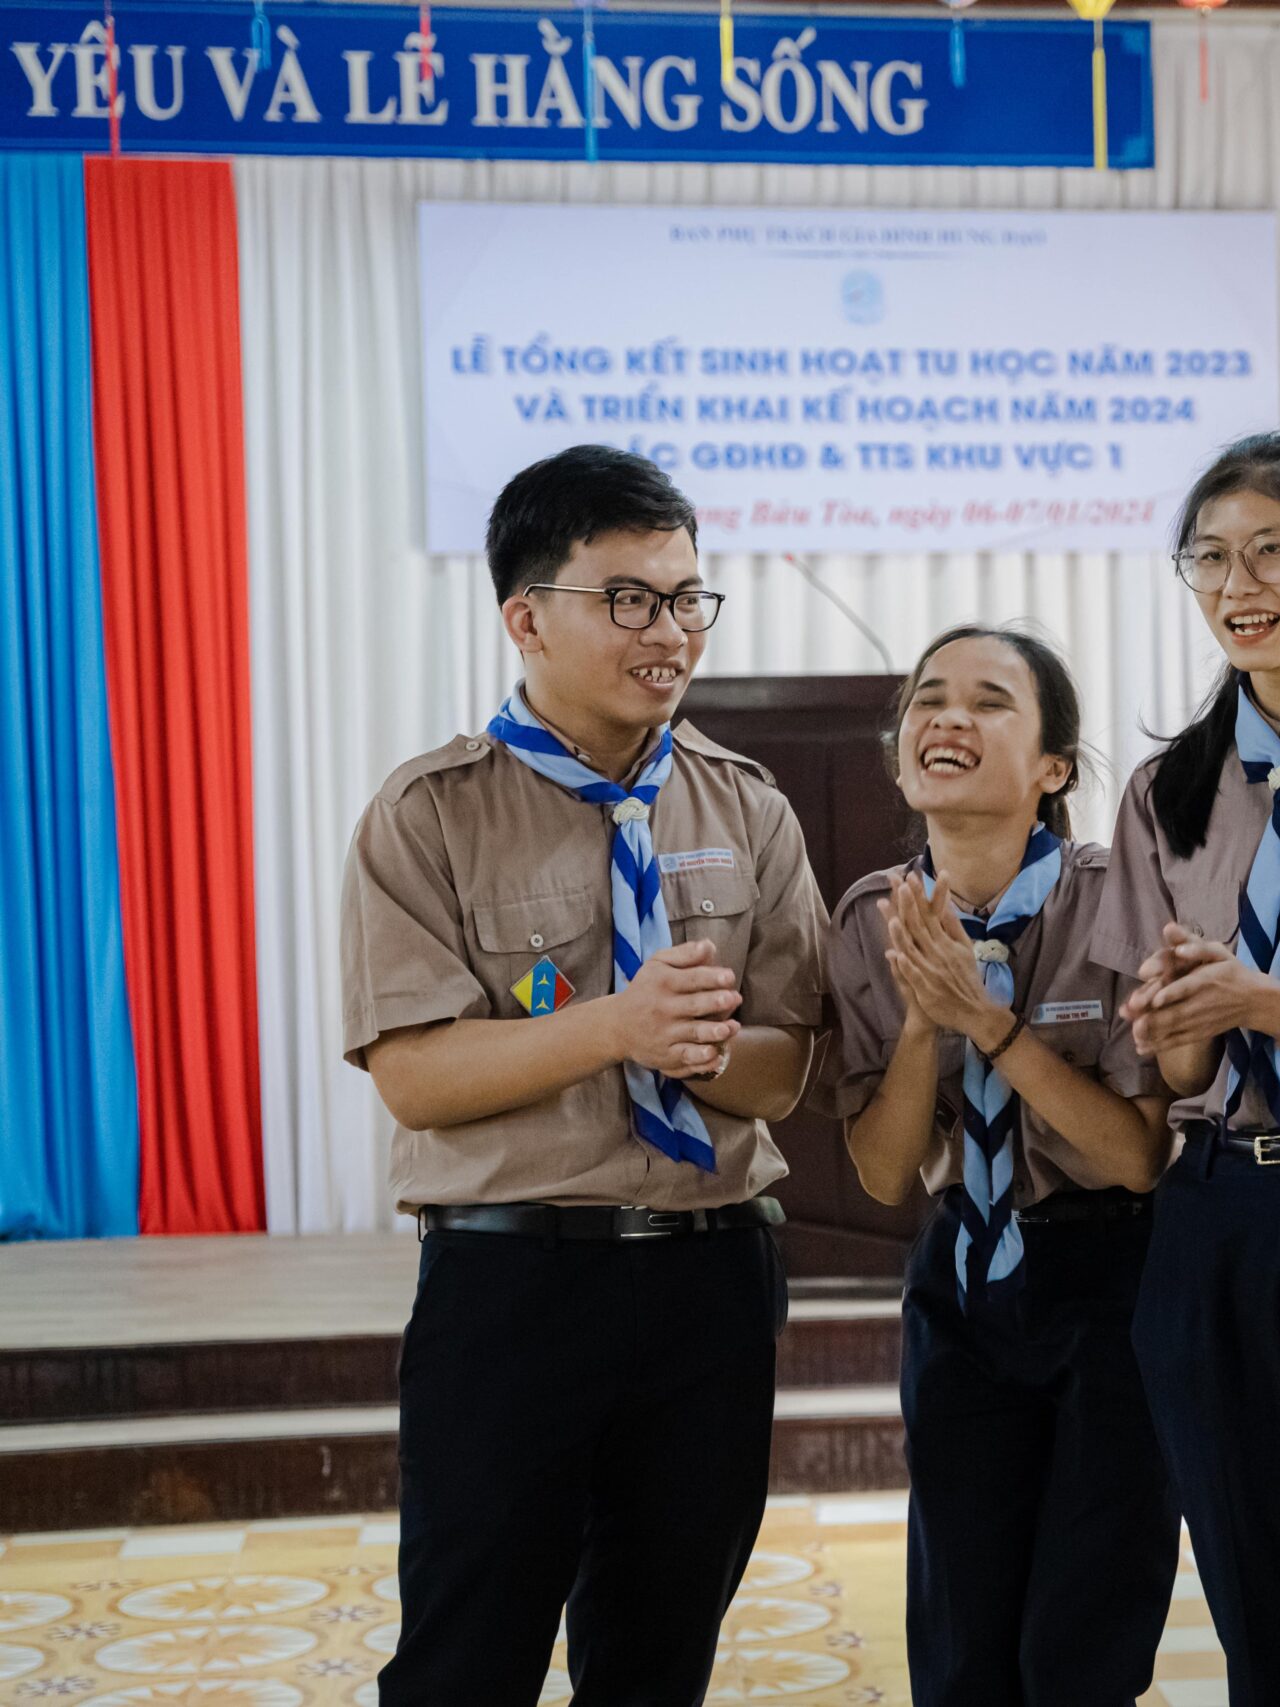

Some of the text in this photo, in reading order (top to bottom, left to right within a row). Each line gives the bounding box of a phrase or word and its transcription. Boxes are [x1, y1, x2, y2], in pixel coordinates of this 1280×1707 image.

[10, 18, 928, 136] YÊU VÀ LẼ HẰNG SỐNG
[451, 332, 1252, 385] LỄ TỔNG KẾT SINH HOẠT TU HỌC NĂM 2023
[515, 381, 1196, 432] VÀ TRIỂN KHAI KẾ HOẠCH NĂM 2024
[692, 443, 806, 470] GĐHĐ
[820, 443, 843, 470] &
[858, 444, 913, 470] TTS
[926, 444, 1001, 470] KHU
[1014, 442, 1093, 478] VỰC
[1107, 445, 1123, 470] 1
